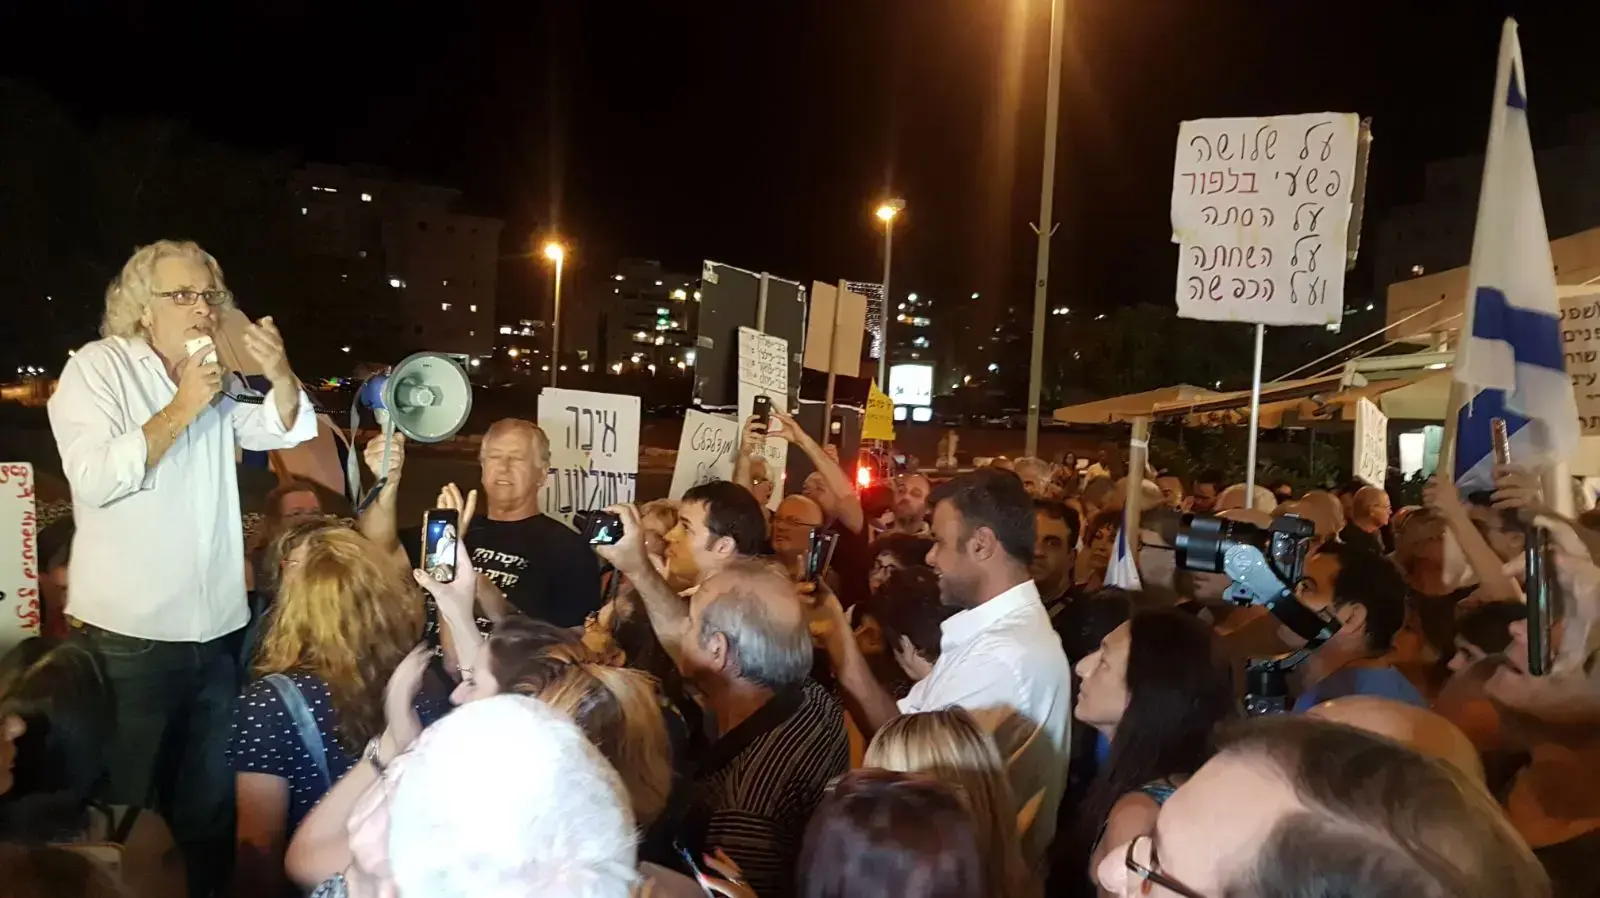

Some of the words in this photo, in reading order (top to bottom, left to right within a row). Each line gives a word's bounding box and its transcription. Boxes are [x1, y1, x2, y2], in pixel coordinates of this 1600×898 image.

[1190, 125, 1278, 162] שלושה
[1300, 121, 1334, 161] על
[1181, 168, 1259, 195] בלפור
[1275, 165, 1341, 197] פשעי
[1201, 206, 1275, 228] הסתה
[1293, 202, 1325, 232] על
[1190, 246, 1274, 271] השחתה
[1291, 234, 1322, 272] על
[1188, 275, 1275, 302] הכפשה
[1290, 270, 1328, 306] ועל
